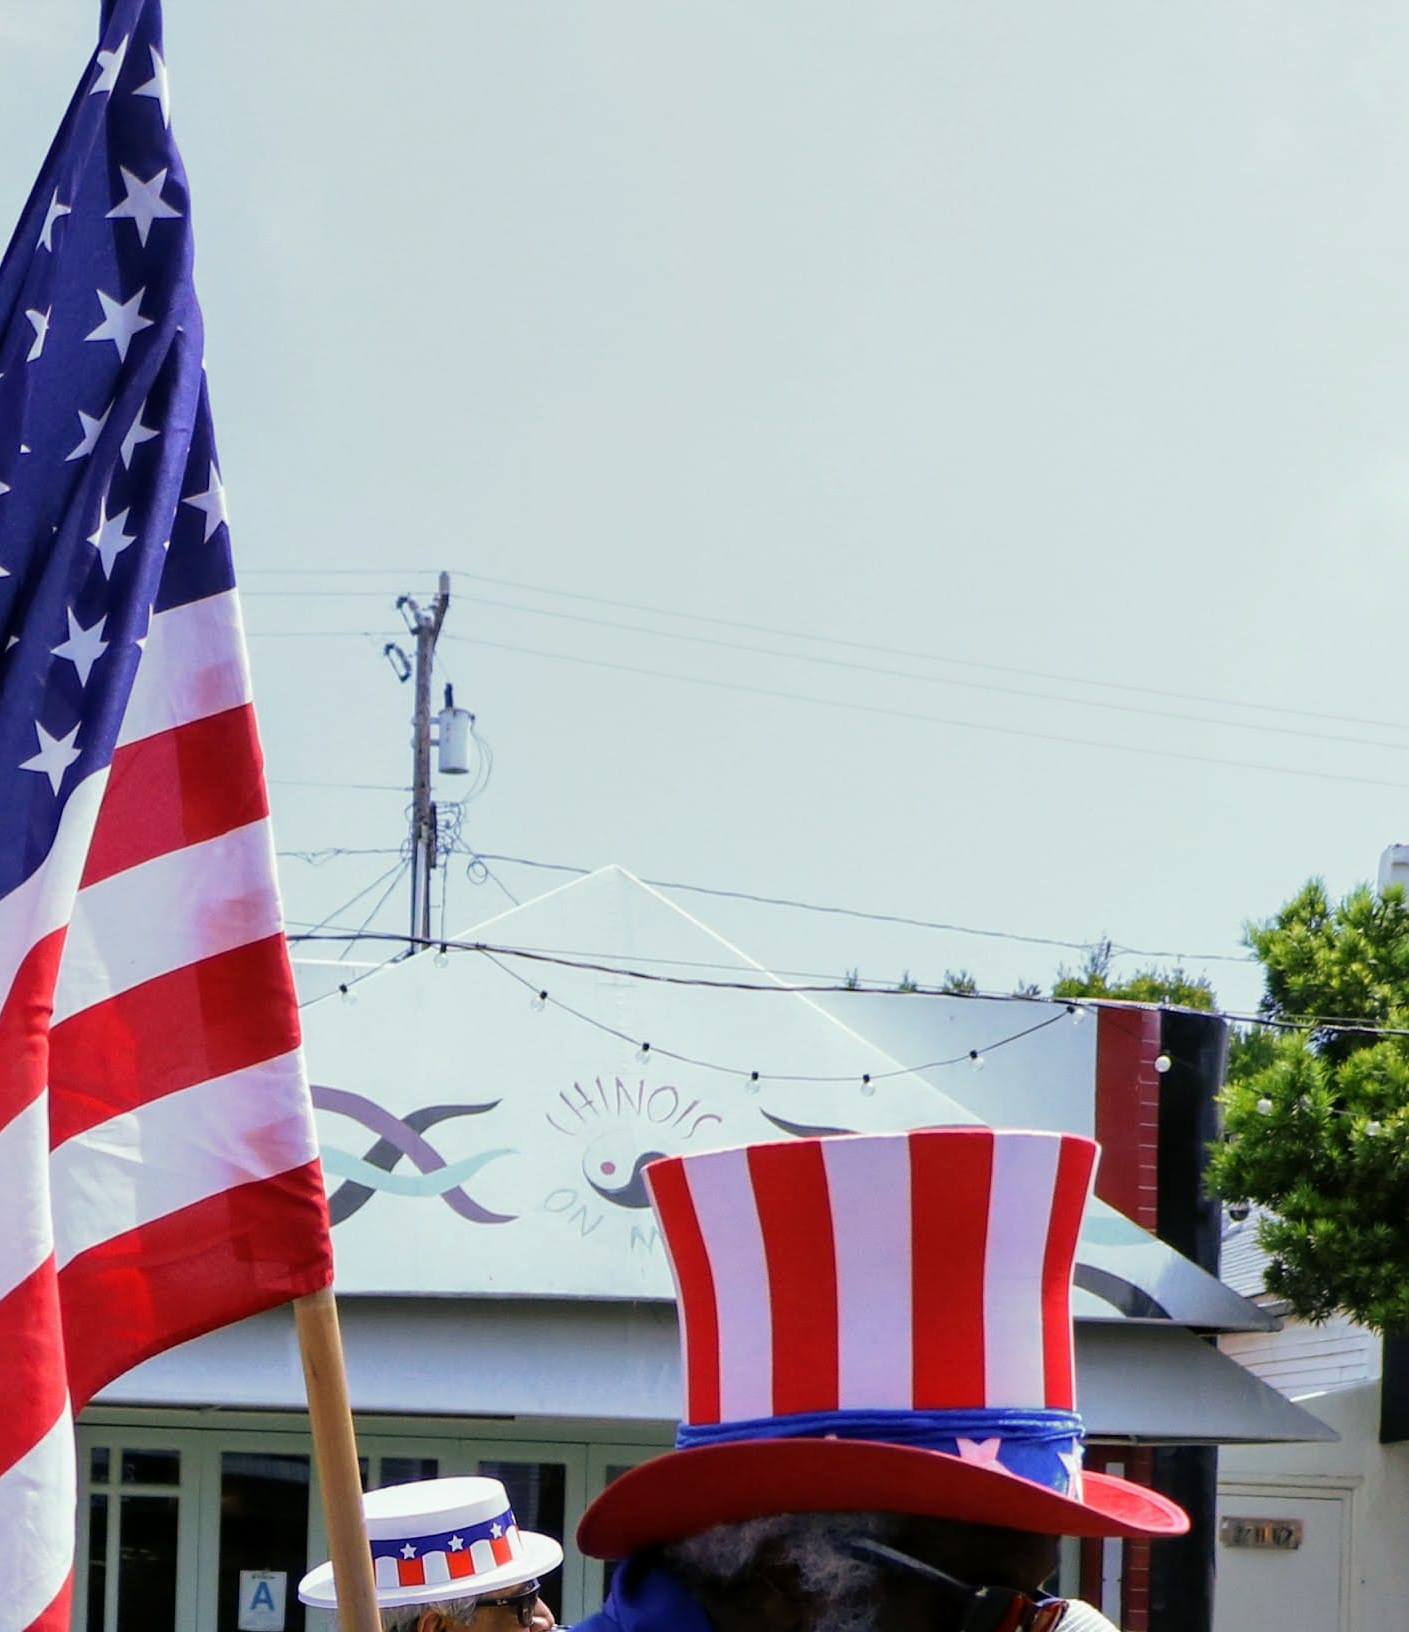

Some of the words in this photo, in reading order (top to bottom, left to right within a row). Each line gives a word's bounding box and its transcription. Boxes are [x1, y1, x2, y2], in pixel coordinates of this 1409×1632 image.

[545, 1076, 723, 1140] CHINOIS
[544, 1188, 604, 1238] ON
[249, 1581, 275, 1611] A
